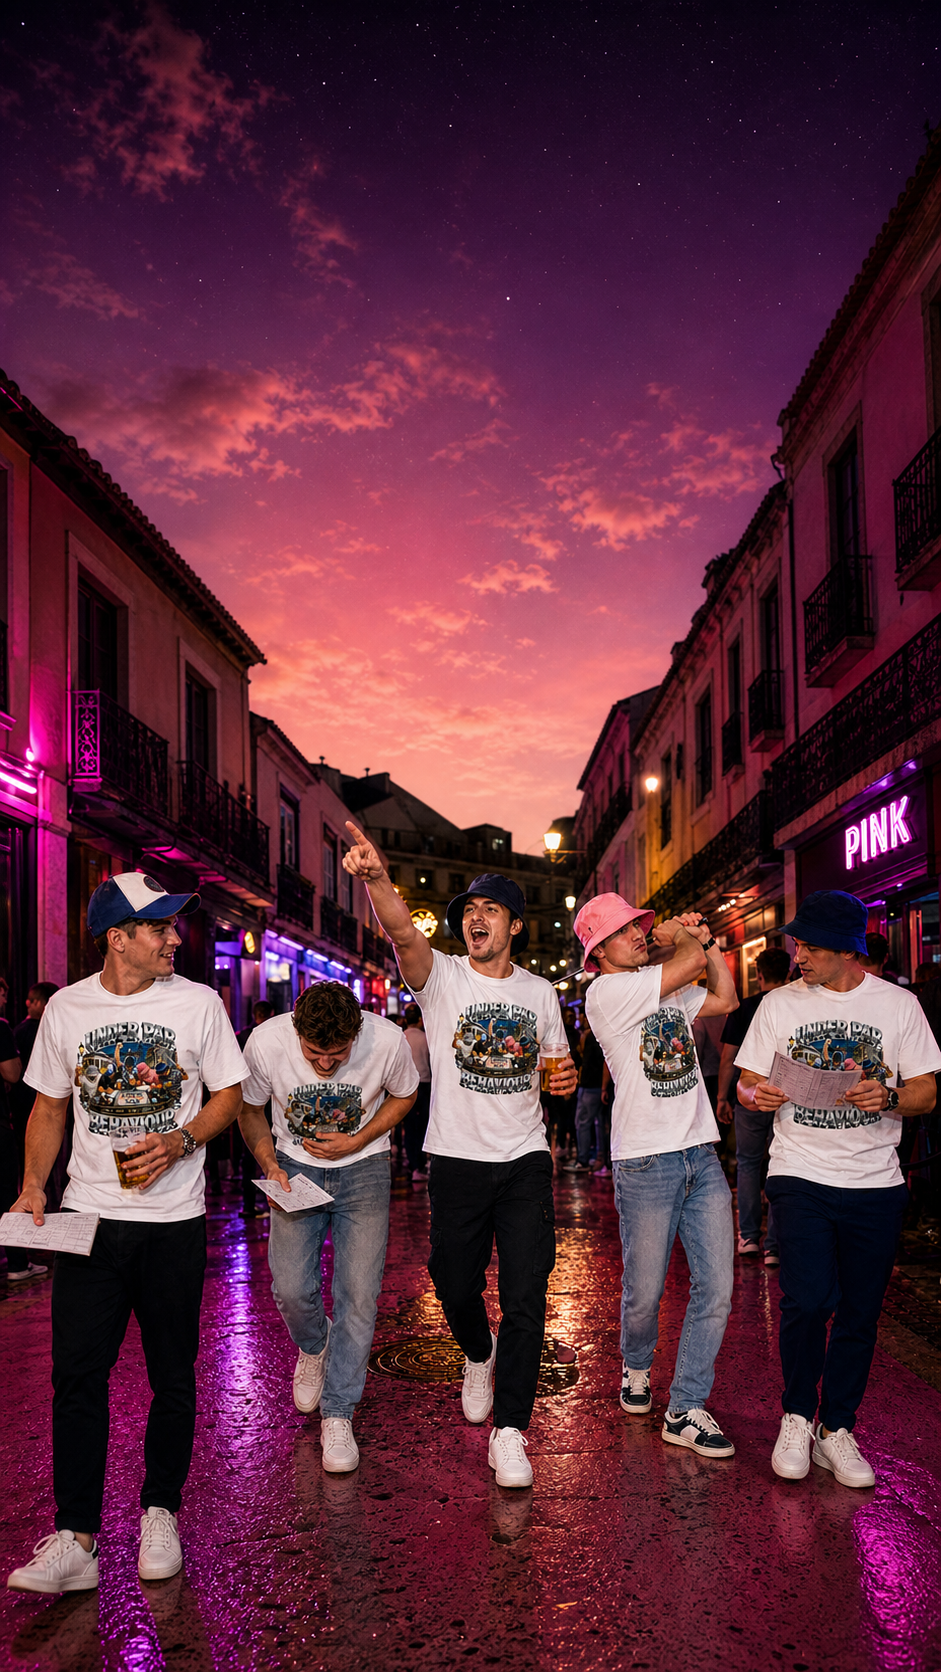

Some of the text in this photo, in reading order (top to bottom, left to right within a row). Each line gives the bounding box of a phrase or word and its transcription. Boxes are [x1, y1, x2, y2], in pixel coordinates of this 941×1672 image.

[845, 795, 910, 869] PINK
[84, 1022, 177, 1049] UNDER PAR
[795, 1020, 883, 1048] UNDER PAR
[459, 1072, 532, 1095] BEHAVIOUR
